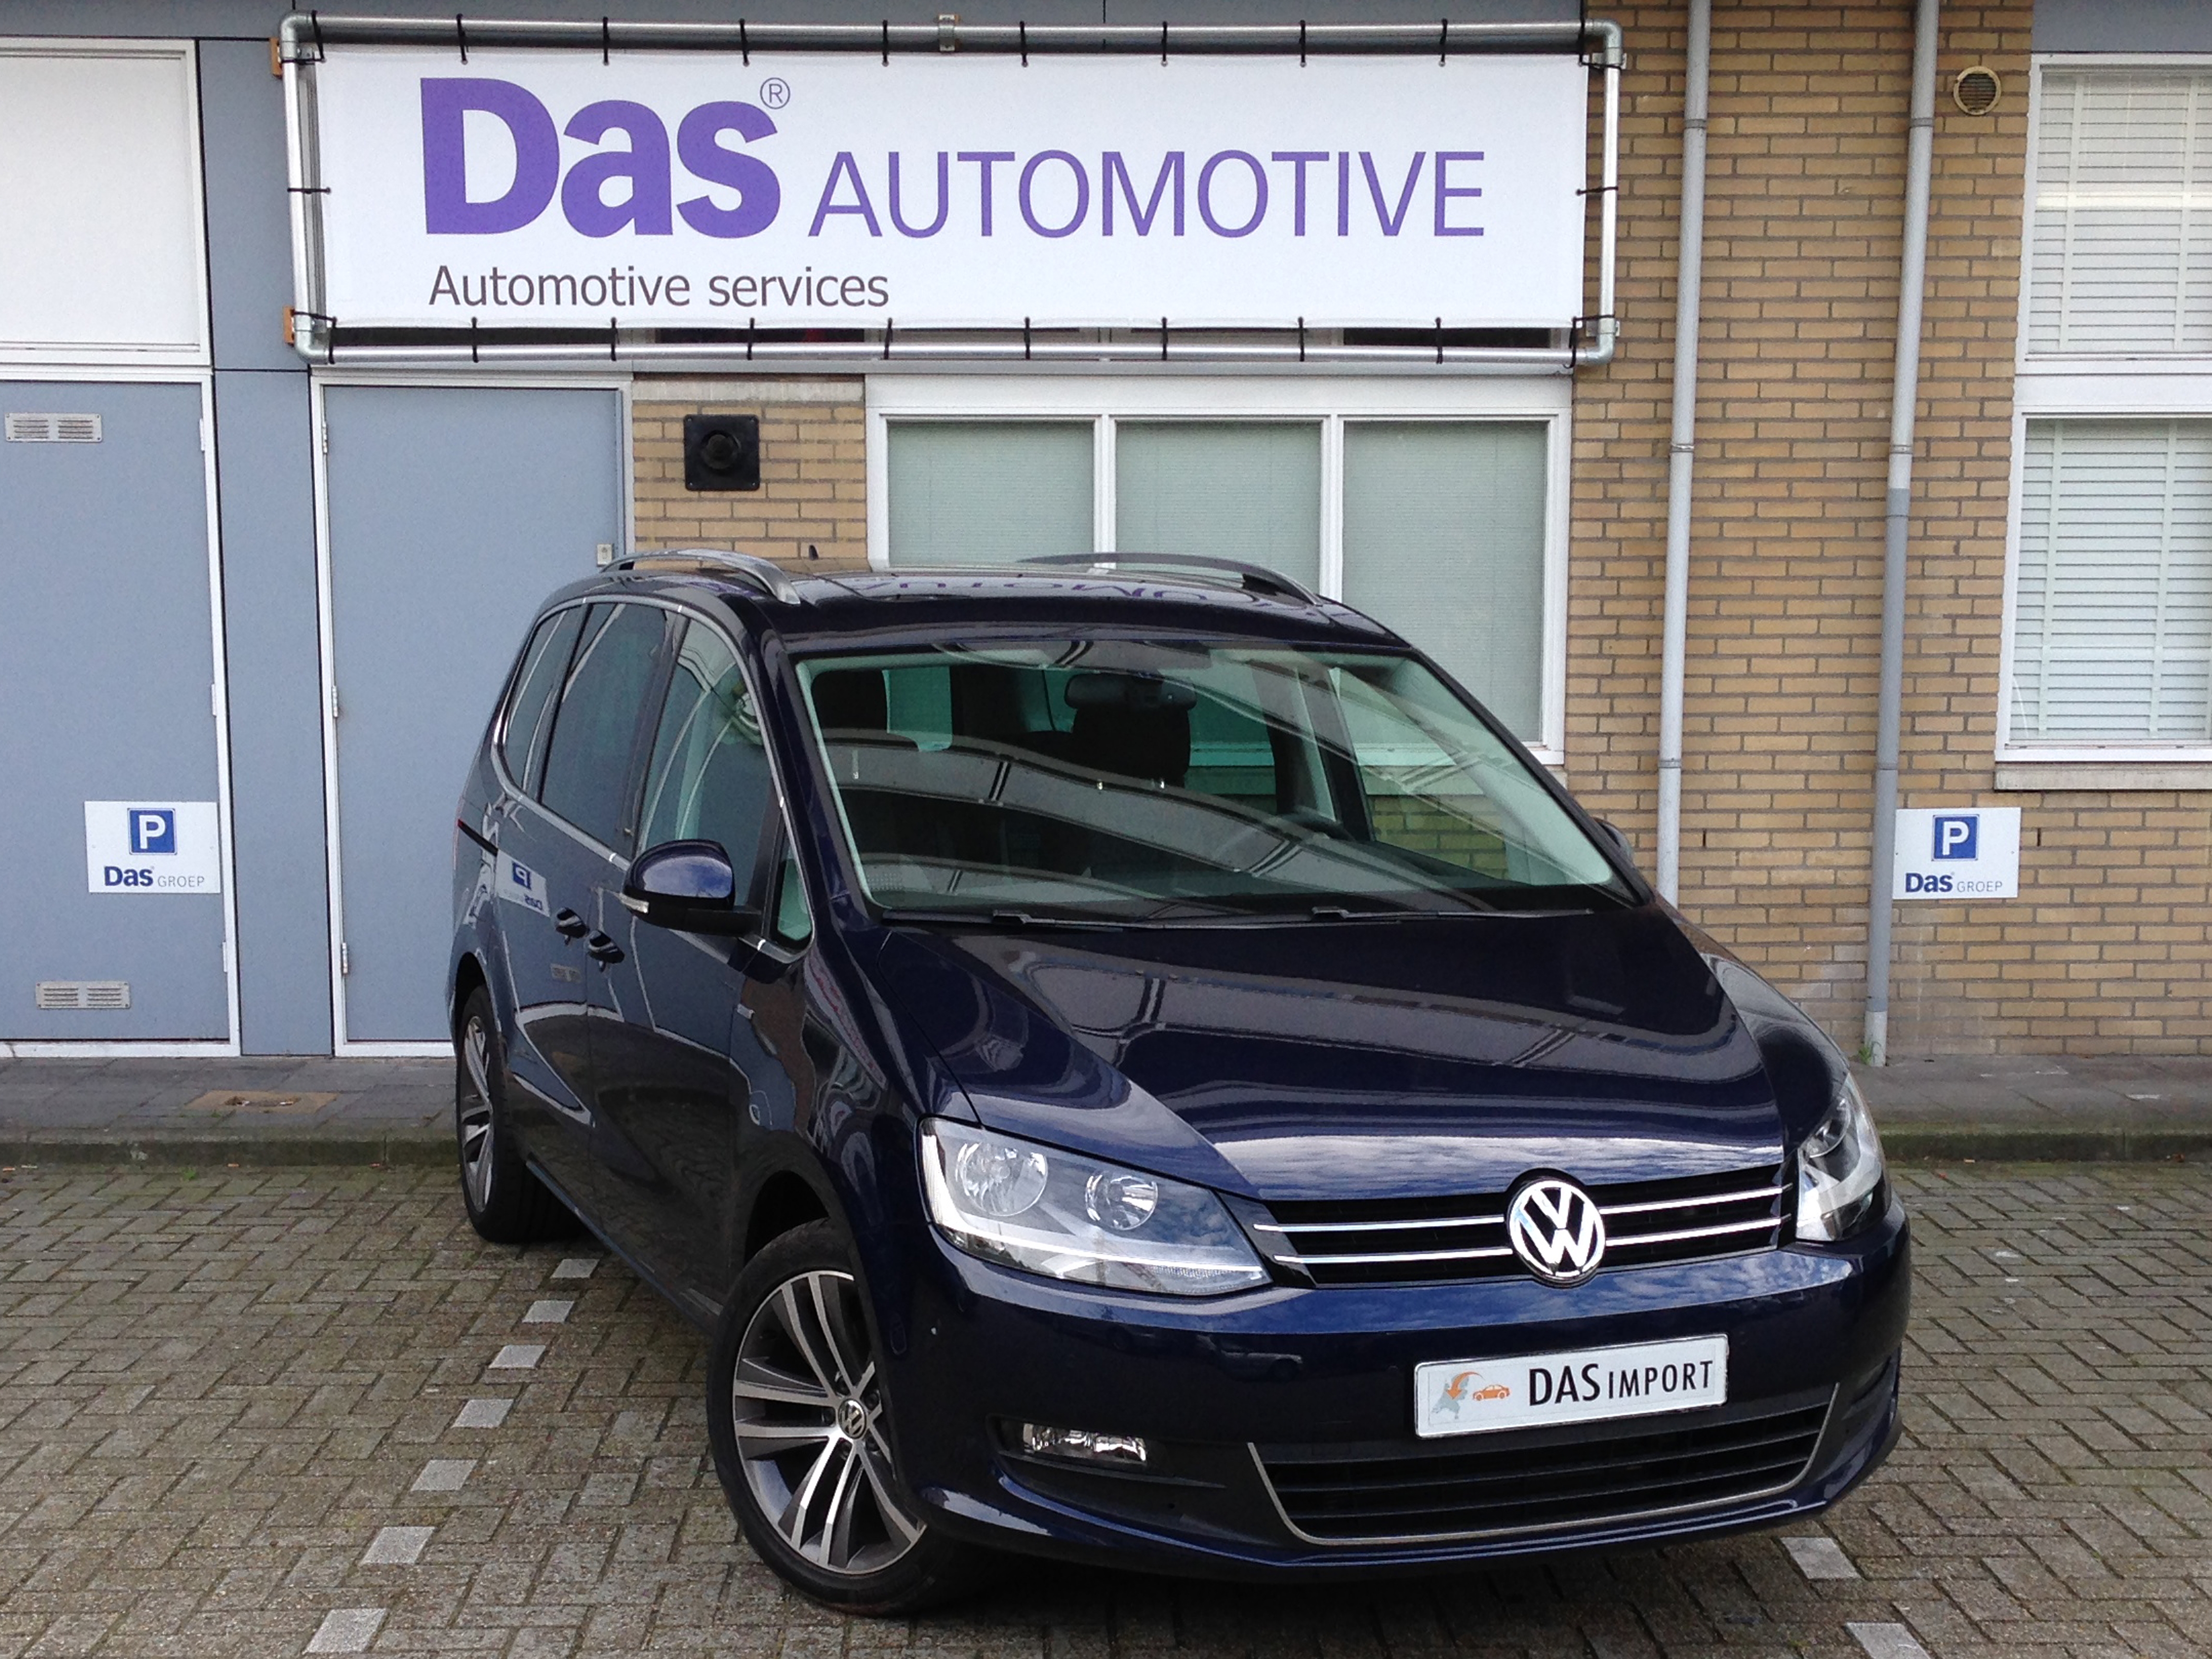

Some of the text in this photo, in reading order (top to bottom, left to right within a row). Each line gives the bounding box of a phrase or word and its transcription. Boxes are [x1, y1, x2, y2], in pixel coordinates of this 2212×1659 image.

[807, 149, 1485, 239] AUTOMOTIVE
[429, 265, 889, 307] Automotive services
[139, 815, 166, 849] P
[1942, 821, 1969, 855] P
[104, 866, 204, 888] Das GROEP
[1905, 873, 2002, 893] Das GROEP
[1528, 1360, 1714, 1407] DAS IMPORT
